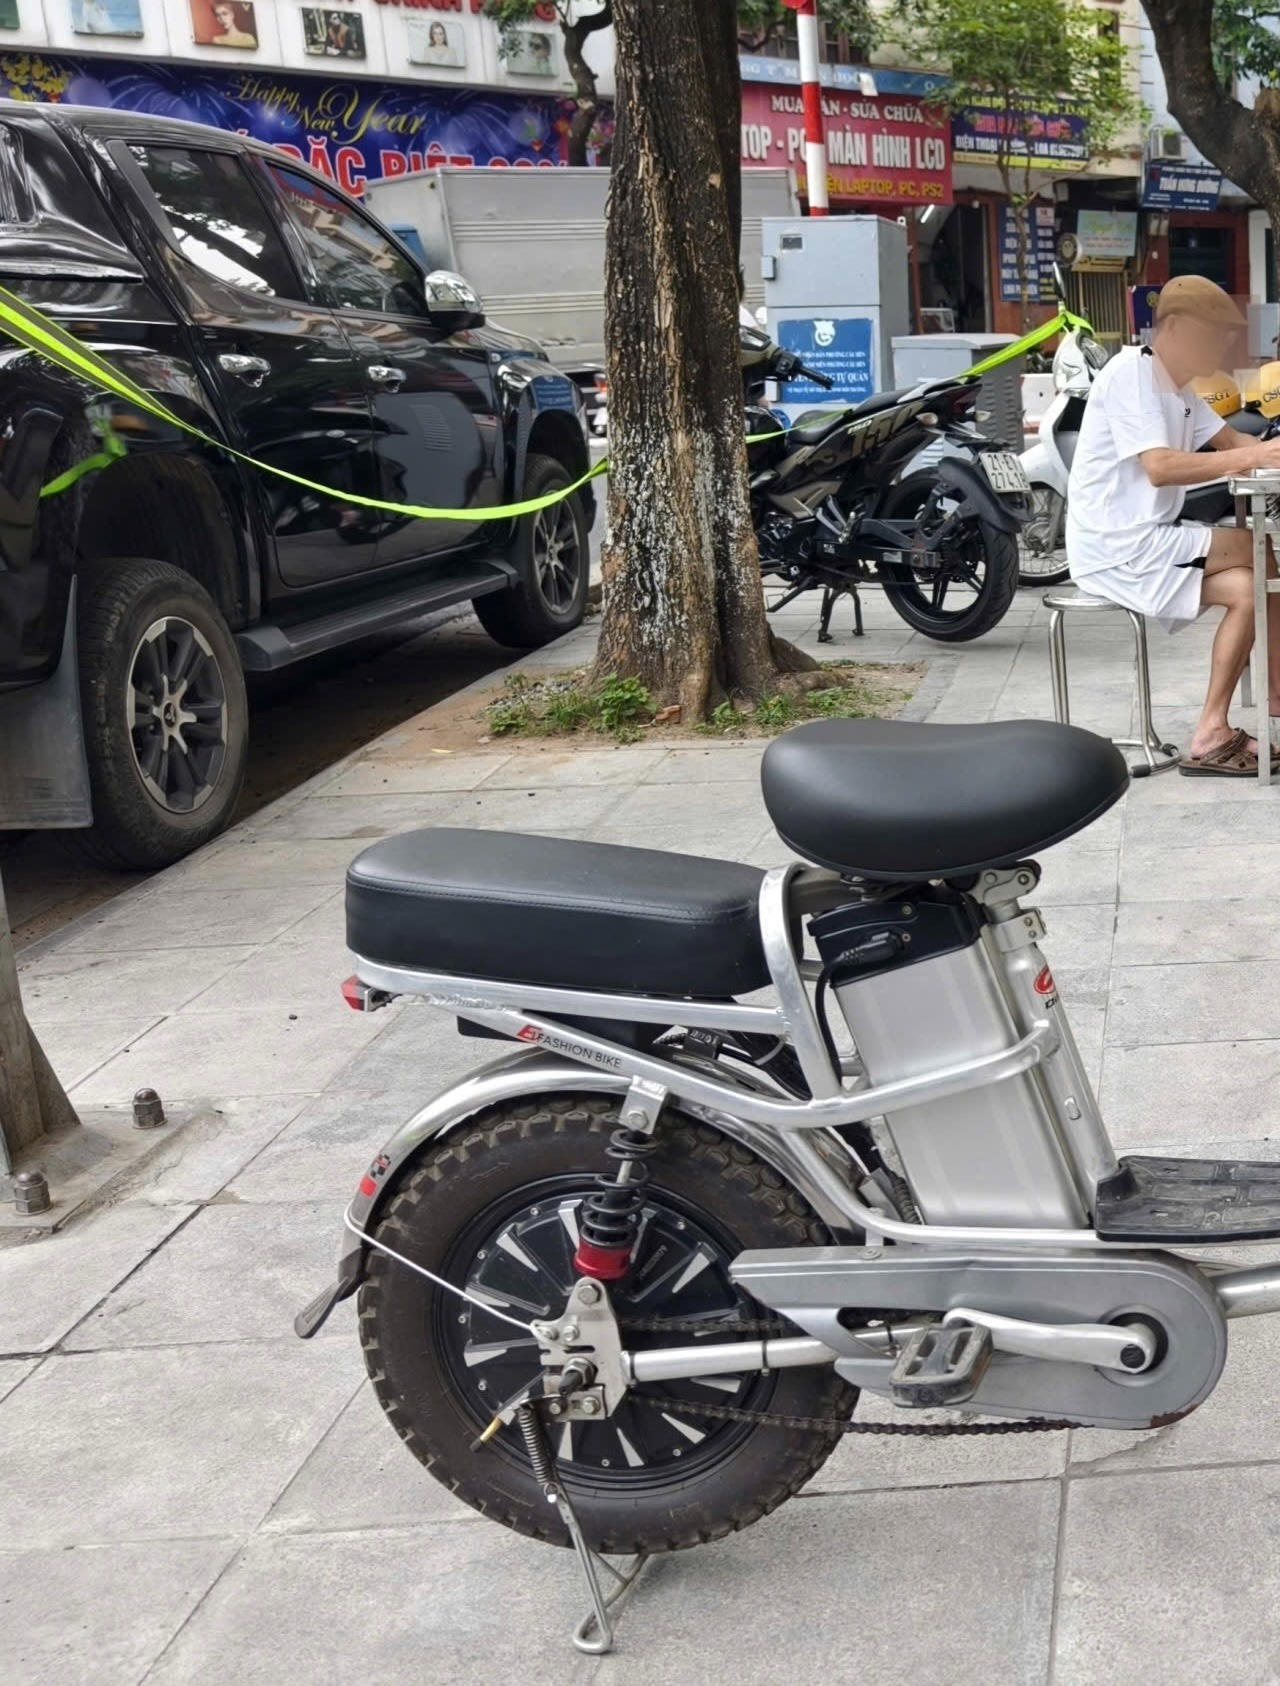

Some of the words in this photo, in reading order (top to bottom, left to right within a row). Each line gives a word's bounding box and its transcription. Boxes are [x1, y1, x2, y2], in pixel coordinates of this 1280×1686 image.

[225, 73, 302, 112] Happy
[283, 109, 336, 131] New
[319, 83, 427, 145] Year
[771, 95, 804, 114] MUA
[884, 101, 924, 123] CHỮA
[828, 123, 868, 166] MÀN
[873, 127, 912, 169] HÌNH
[915, 136, 946, 171] LCD
[535, 1032, 593, 1059] FASHION
[594, 1052, 623, 1069] BIKE
